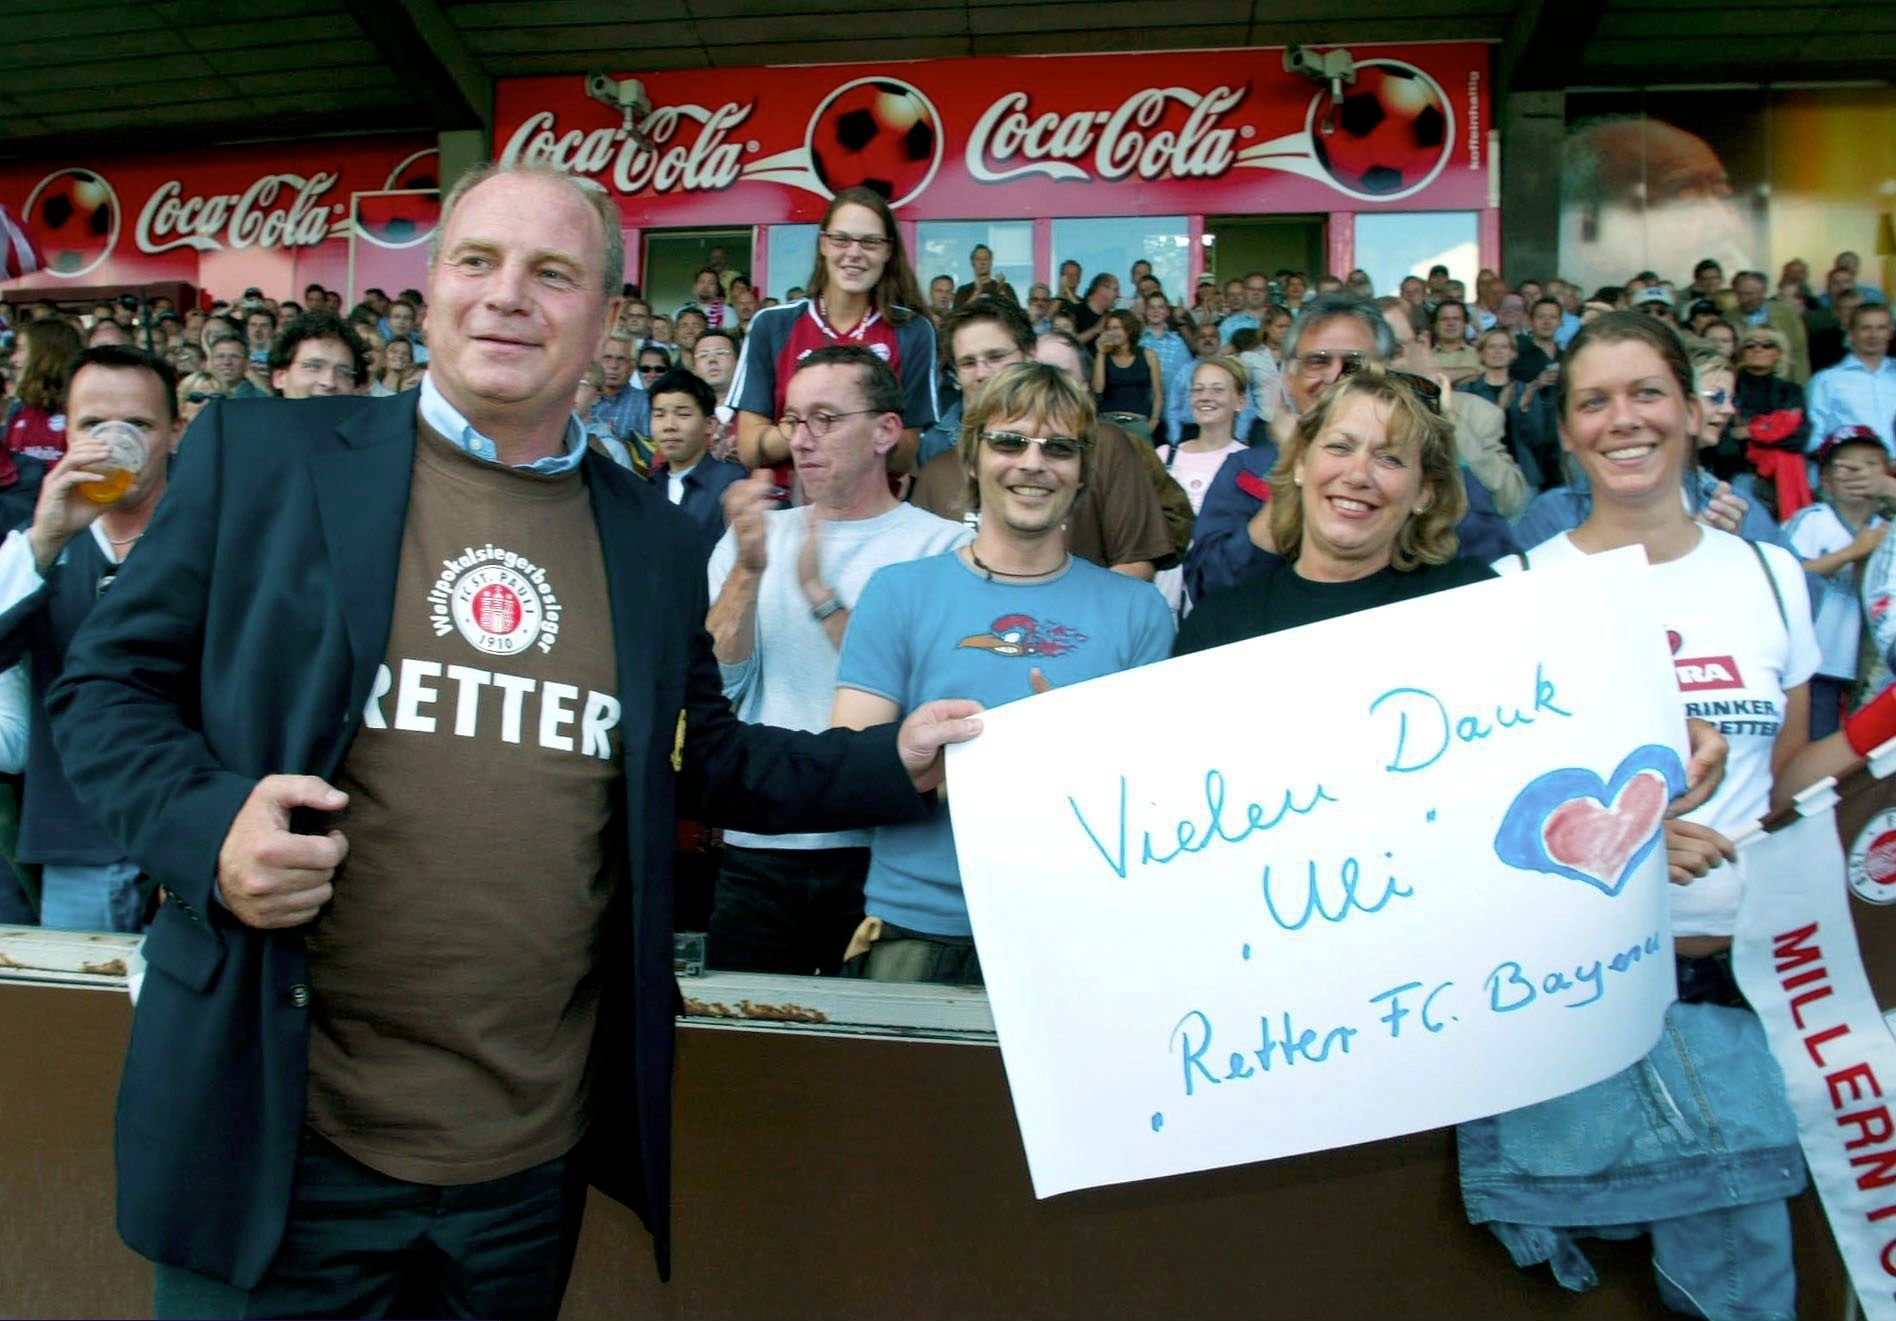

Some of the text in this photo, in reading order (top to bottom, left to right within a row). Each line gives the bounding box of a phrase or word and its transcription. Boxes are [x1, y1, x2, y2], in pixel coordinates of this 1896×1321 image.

[500, 102, 753, 193] Coca-Cola
[966, 86, 1246, 181] Coca-Cola
[135, 171, 339, 253] Coca-Cola
[479, 634, 514, 650] 1910
[362, 658, 622, 760] RETTER
[1685, 700, 1778, 717] RINKER
[1067, 662, 1573, 878] Vielen Dank
[1263, 851, 1414, 930] Uli
[1170, 1010, 1358, 1096] Retter
[1484, 932, 1660, 1013] Bayern
